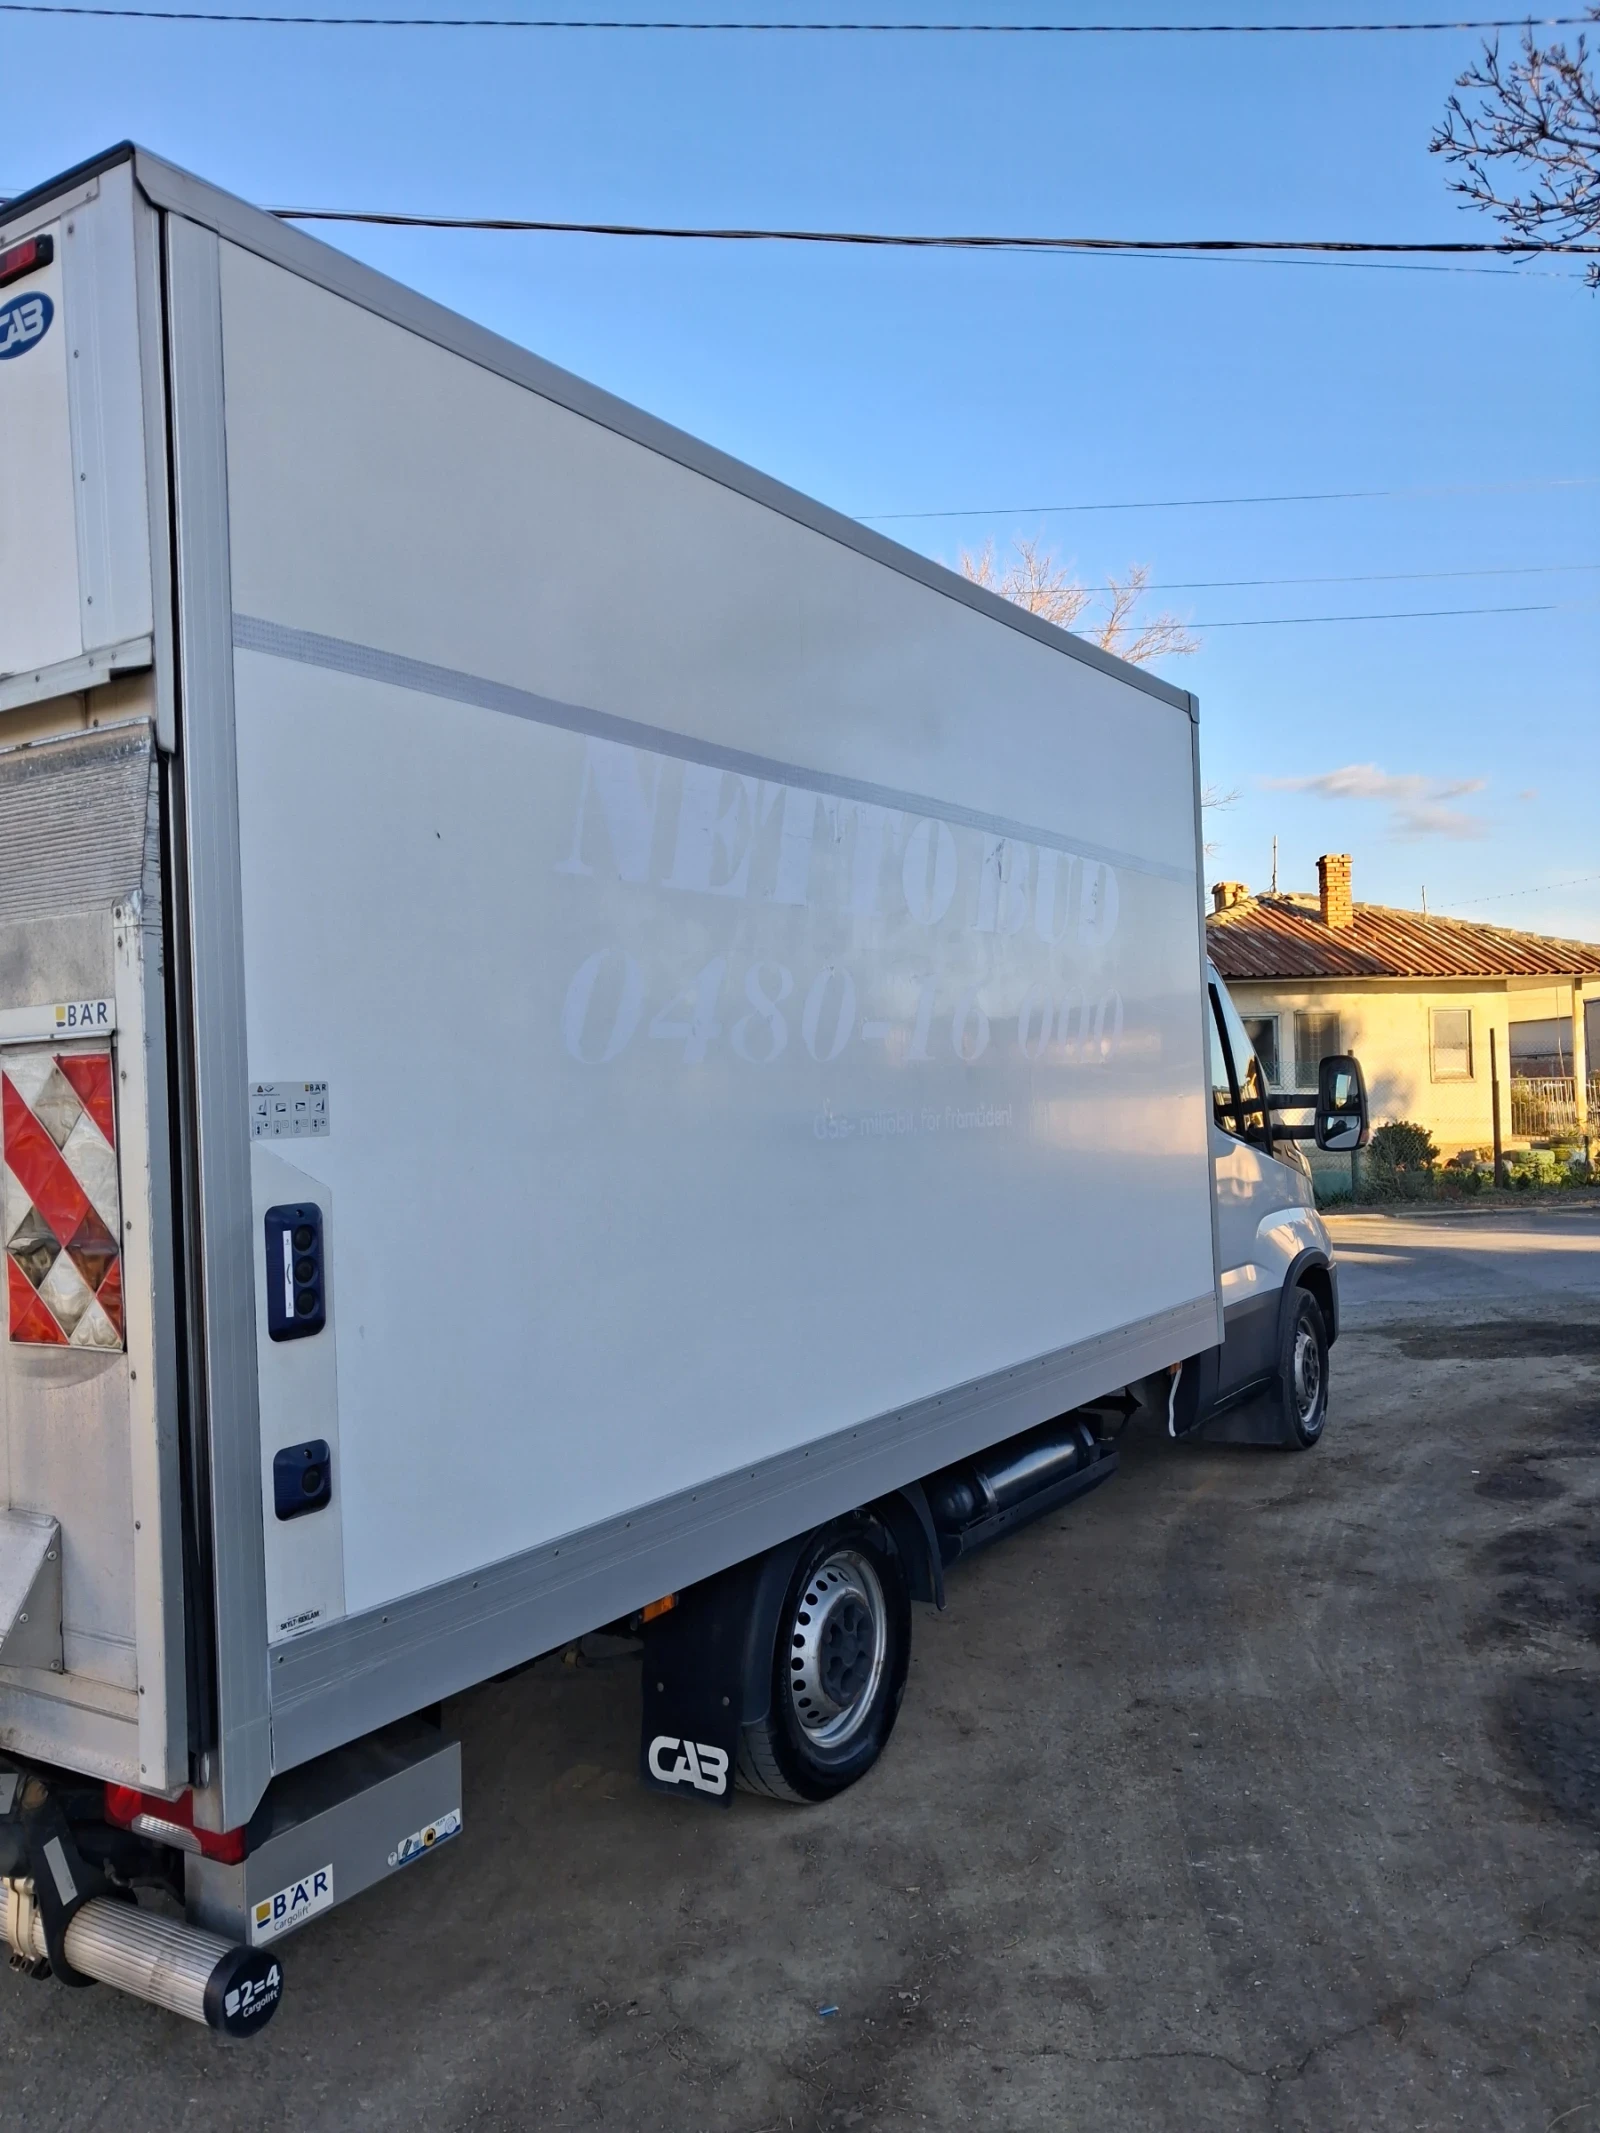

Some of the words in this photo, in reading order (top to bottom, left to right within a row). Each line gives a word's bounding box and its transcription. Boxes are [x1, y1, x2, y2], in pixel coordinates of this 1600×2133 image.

[552, 736, 957, 925] NETTO
[969, 833, 1120, 947] BUD
[68, 1002, 107, 1026] BÄR
[562, 946, 990, 1065] 0480-16
[648, 1735, 729, 1796] CAB
[273, 1871, 328, 1920] BÄR
[241, 1964, 280, 2007] 2=4
